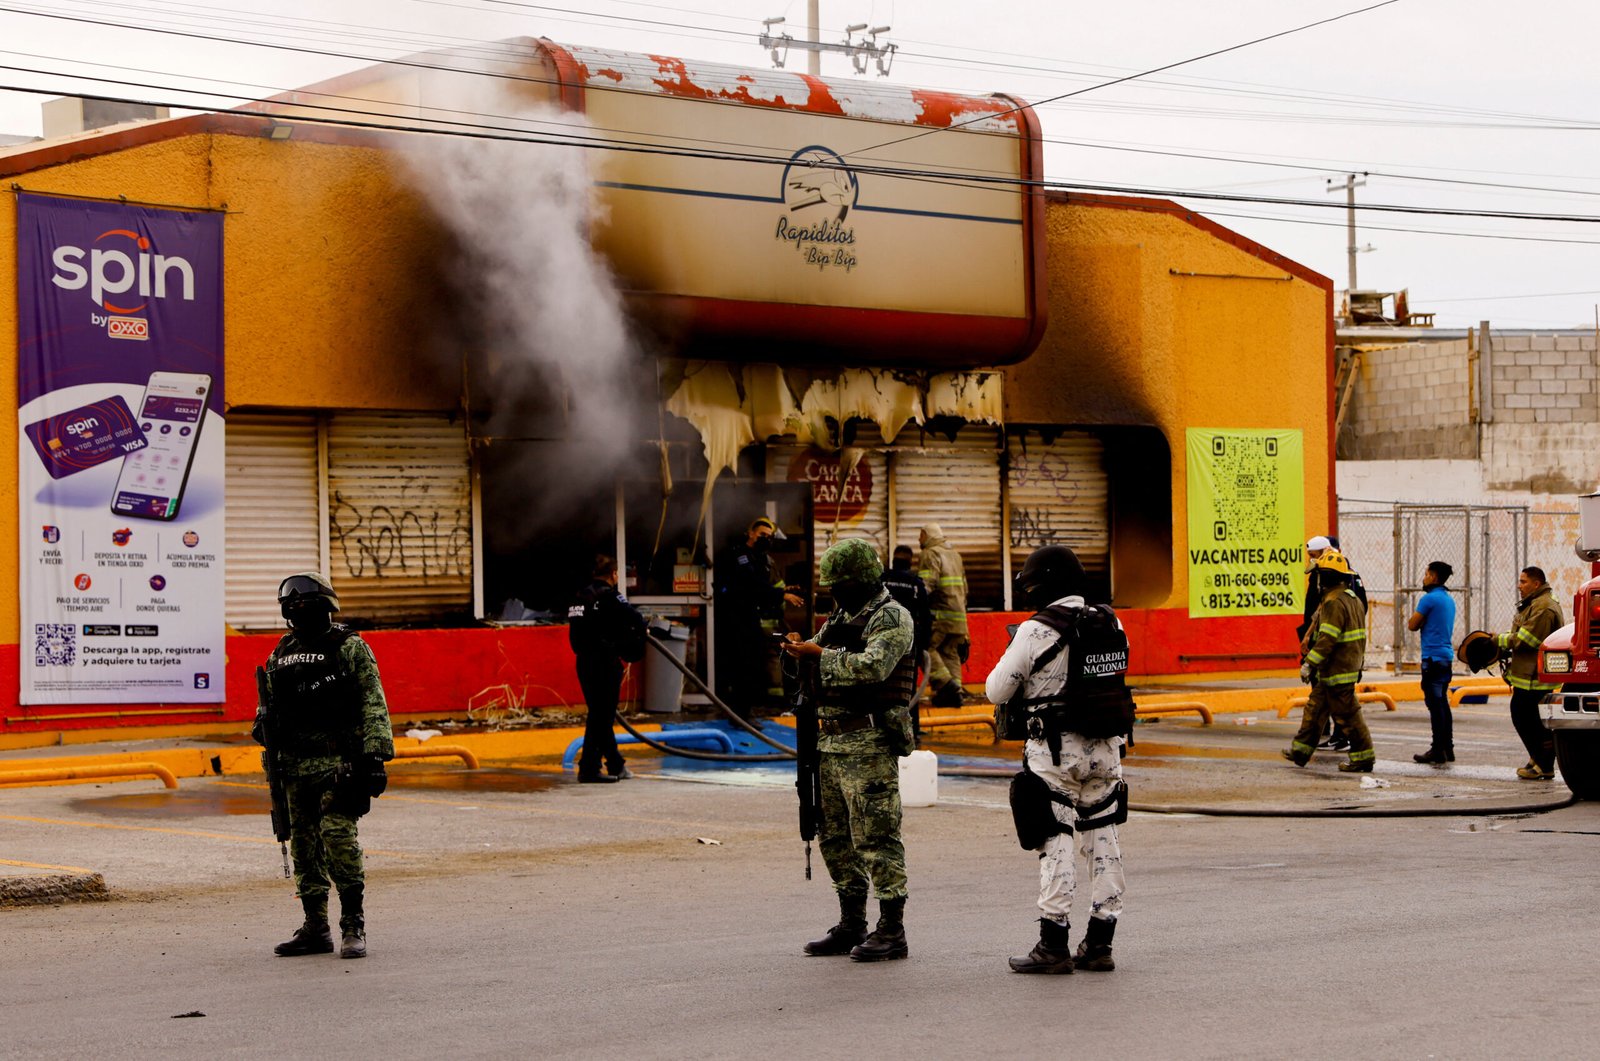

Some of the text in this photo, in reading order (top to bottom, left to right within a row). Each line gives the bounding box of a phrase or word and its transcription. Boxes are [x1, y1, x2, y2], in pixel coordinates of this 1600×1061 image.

[776, 217, 855, 248] Rapiditos
[807, 247, 856, 271] Bip Bip
[51, 236, 195, 307] spin
[91, 312, 148, 336] by OXXO
[66, 417, 99, 435] spin
[121, 439, 145, 452] VISA
[805, 459, 861, 482] CARA
[95, 552, 121, 560] DEPOSITA
[1190, 544, 1303, 566] VACANTES AQUÍ
[1214, 572, 1289, 588] 811-660-6996
[1209, 591, 1294, 609] 813-231-6996
[157, 605, 181, 613] QUIERAS
[83, 646, 128, 655] Descarga
[142, 647, 163, 655] app,
[278, 653, 325, 664] EJERCITO
[1086, 651, 1126, 664] GUARDIA
[83, 658, 89, 666] y
[91, 657, 134, 667] adquiere
[150, 657, 181, 666] tarjeta
[1083, 662, 1128, 675] NACIONAL
